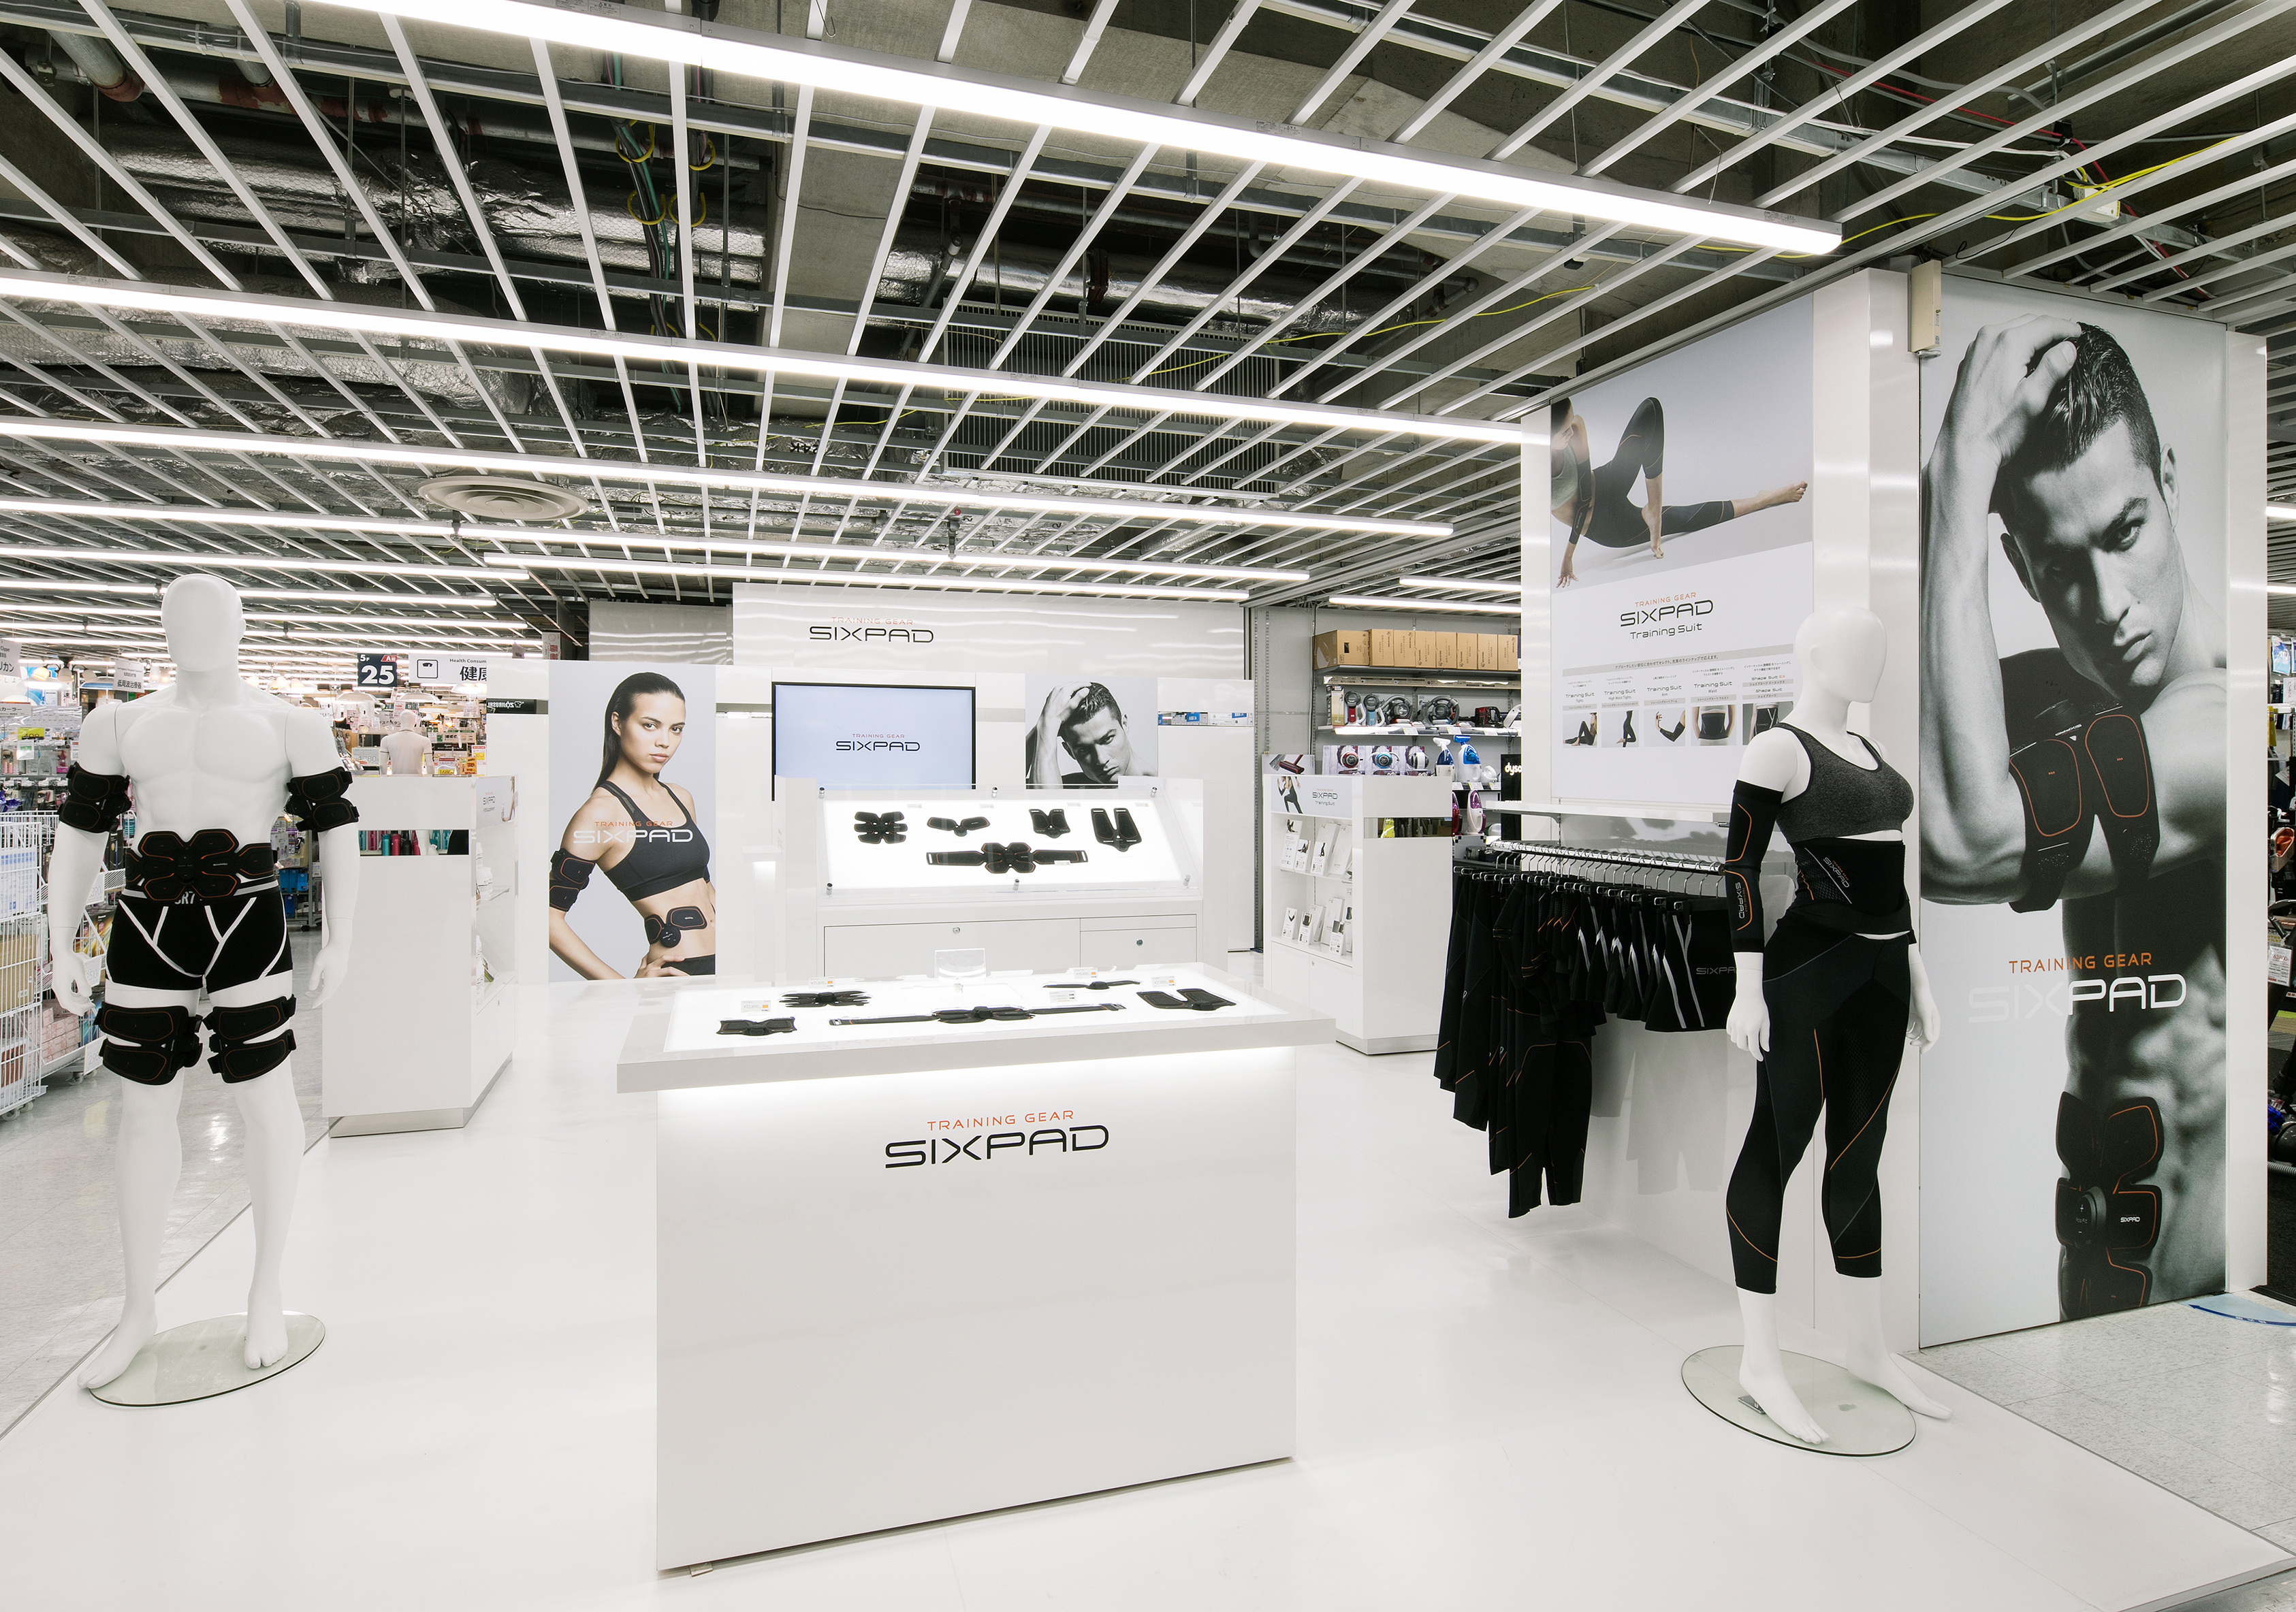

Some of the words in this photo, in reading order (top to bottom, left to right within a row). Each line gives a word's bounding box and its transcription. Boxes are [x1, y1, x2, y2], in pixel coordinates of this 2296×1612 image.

[1635, 596, 1671, 608] TRAINING
[1674, 592, 1697, 601] GEAR
[1620, 599, 1714, 627] SIXPAD
[809, 626, 934, 643] SIXPAD
[1630, 627, 1676, 639] Training
[1678, 623, 1702, 633] Suit
[360, 665, 395, 685] 25
[835, 741, 921, 752] SIXPAD
[1504, 762, 1522, 776] dyso
[1312, 792, 1338, 800] SIXPAD
[573, 828, 693, 844] SIXPAD
[1823, 856, 1850, 888] SIXPAD
[174, 890, 196, 905] R7
[1735, 881, 1746, 920] SIXPAD
[1695, 966, 1737, 976] SIXPA
[2008, 955, 2096, 973] TRAINING
[2104, 952, 2152, 968] GEAR
[1968, 973, 2187, 1024] SIXPAD
[927, 1114, 1017, 1131] TRAINING
[1024, 1110, 1074, 1123] GEAR
[884, 1124, 1110, 1169] SIXPAD
